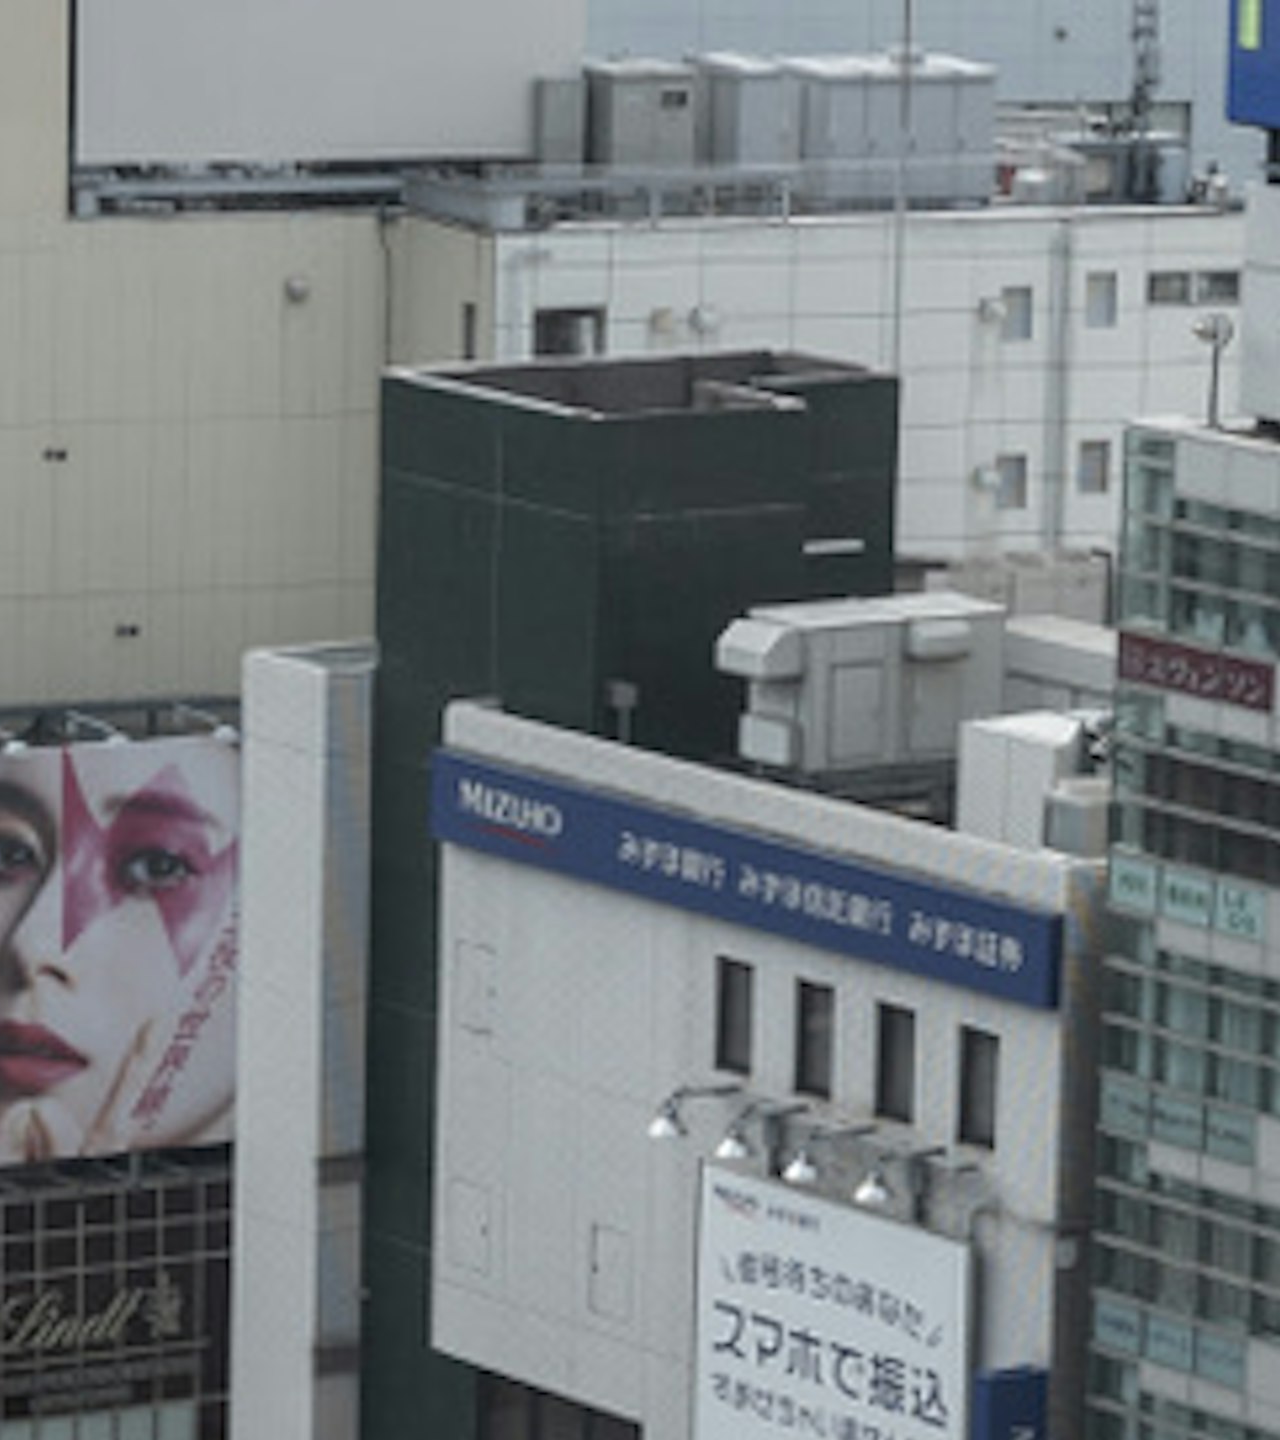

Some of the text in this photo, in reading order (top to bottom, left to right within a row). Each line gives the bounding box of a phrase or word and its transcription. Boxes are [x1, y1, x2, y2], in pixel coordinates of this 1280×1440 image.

[459, 778, 563, 838] MIZUHO
[713, 1298, 949, 1428] スマホで振込
